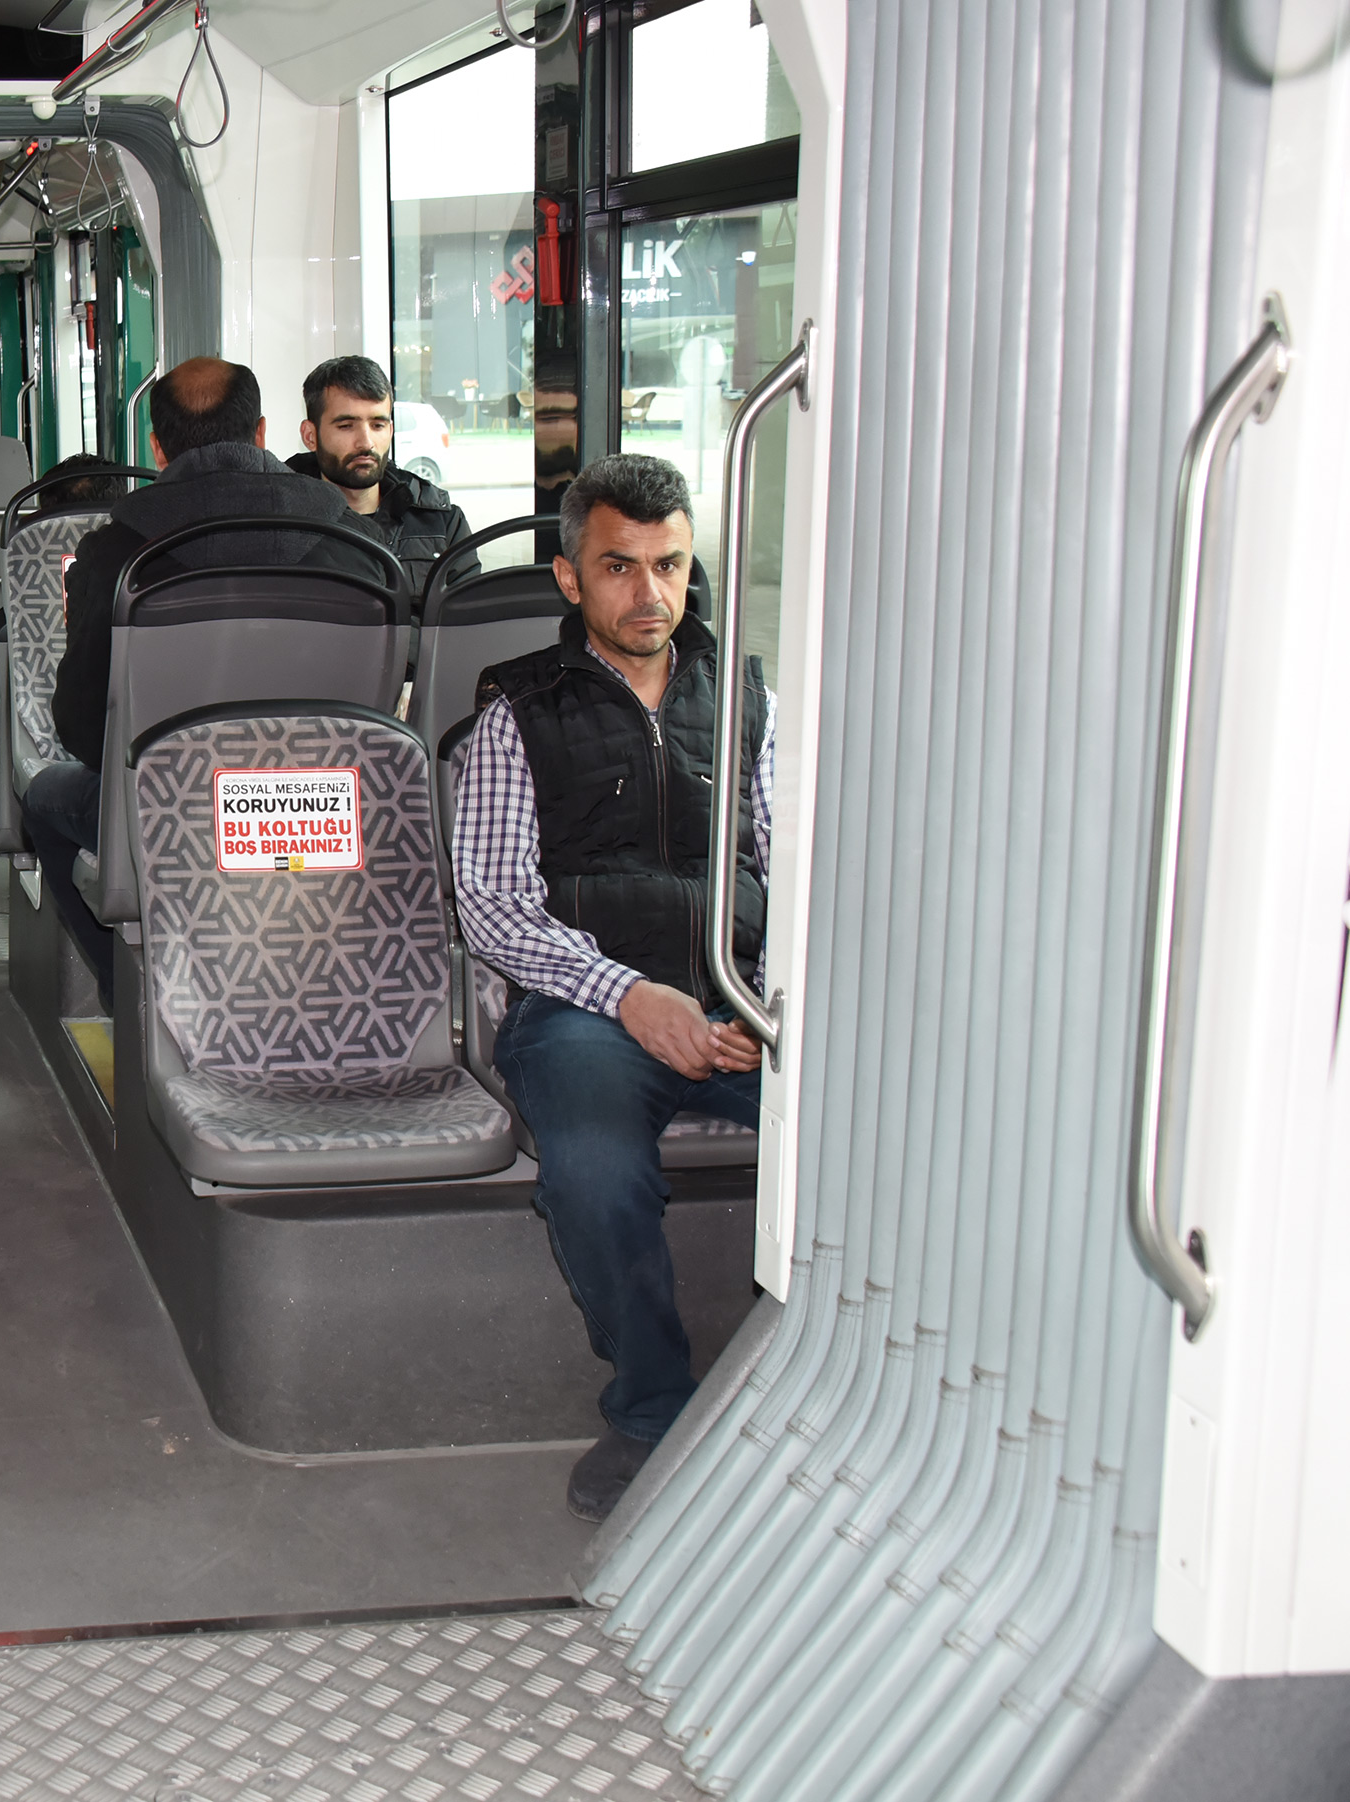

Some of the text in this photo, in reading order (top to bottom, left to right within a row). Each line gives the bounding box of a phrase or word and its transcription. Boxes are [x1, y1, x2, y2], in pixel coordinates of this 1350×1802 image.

[223, 784, 272, 795] SOSYAL
[224, 797, 352, 814] KORUYUNUZ !
[224, 818, 352, 837] BU KOLTUĞU
[225, 838, 352, 856] BOŞ BIRAKINIZ !
